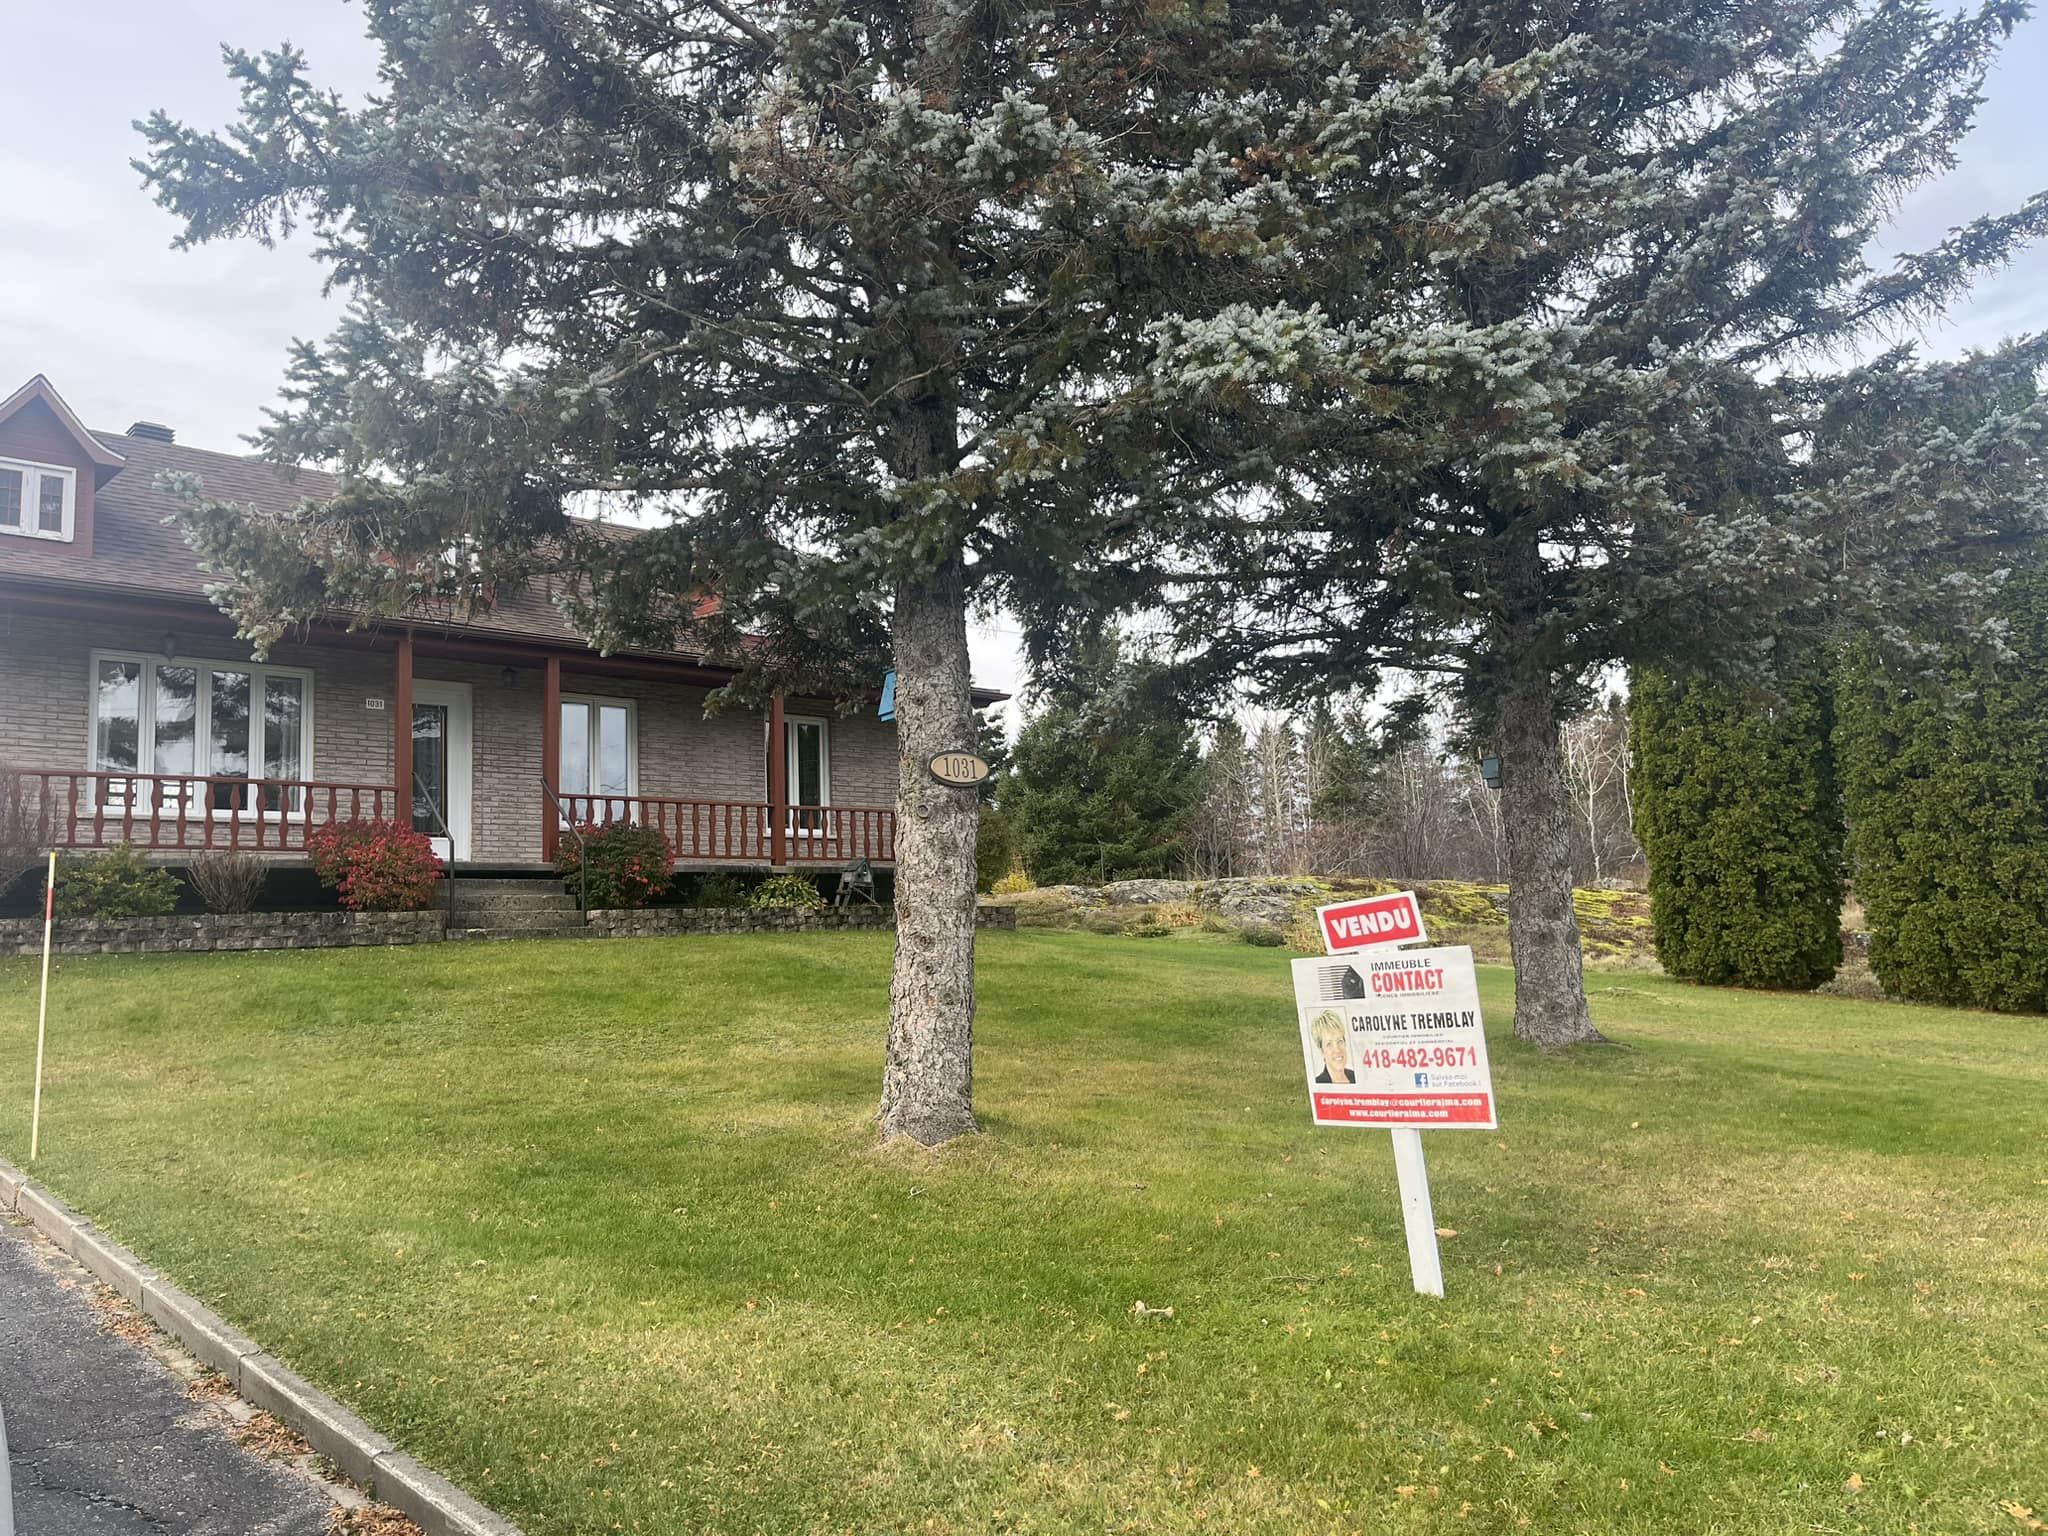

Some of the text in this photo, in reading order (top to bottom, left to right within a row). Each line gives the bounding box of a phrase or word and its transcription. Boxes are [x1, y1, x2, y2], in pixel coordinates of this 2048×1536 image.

[367, 700, 383, 708] 1031
[943, 757, 978, 779] 1031
[1330, 907, 1411, 939] VENDU
[1370, 958, 1431, 971] IMMEUBLE
[1371, 968, 1443, 993] CONTACT
[1351, 1011, 1475, 1032] CAROLYNE TREMBLAY
[1363, 1046, 1477, 1068] 418-482-9671
[1349, 1108, 1448, 1118] www.courtieralma.com
